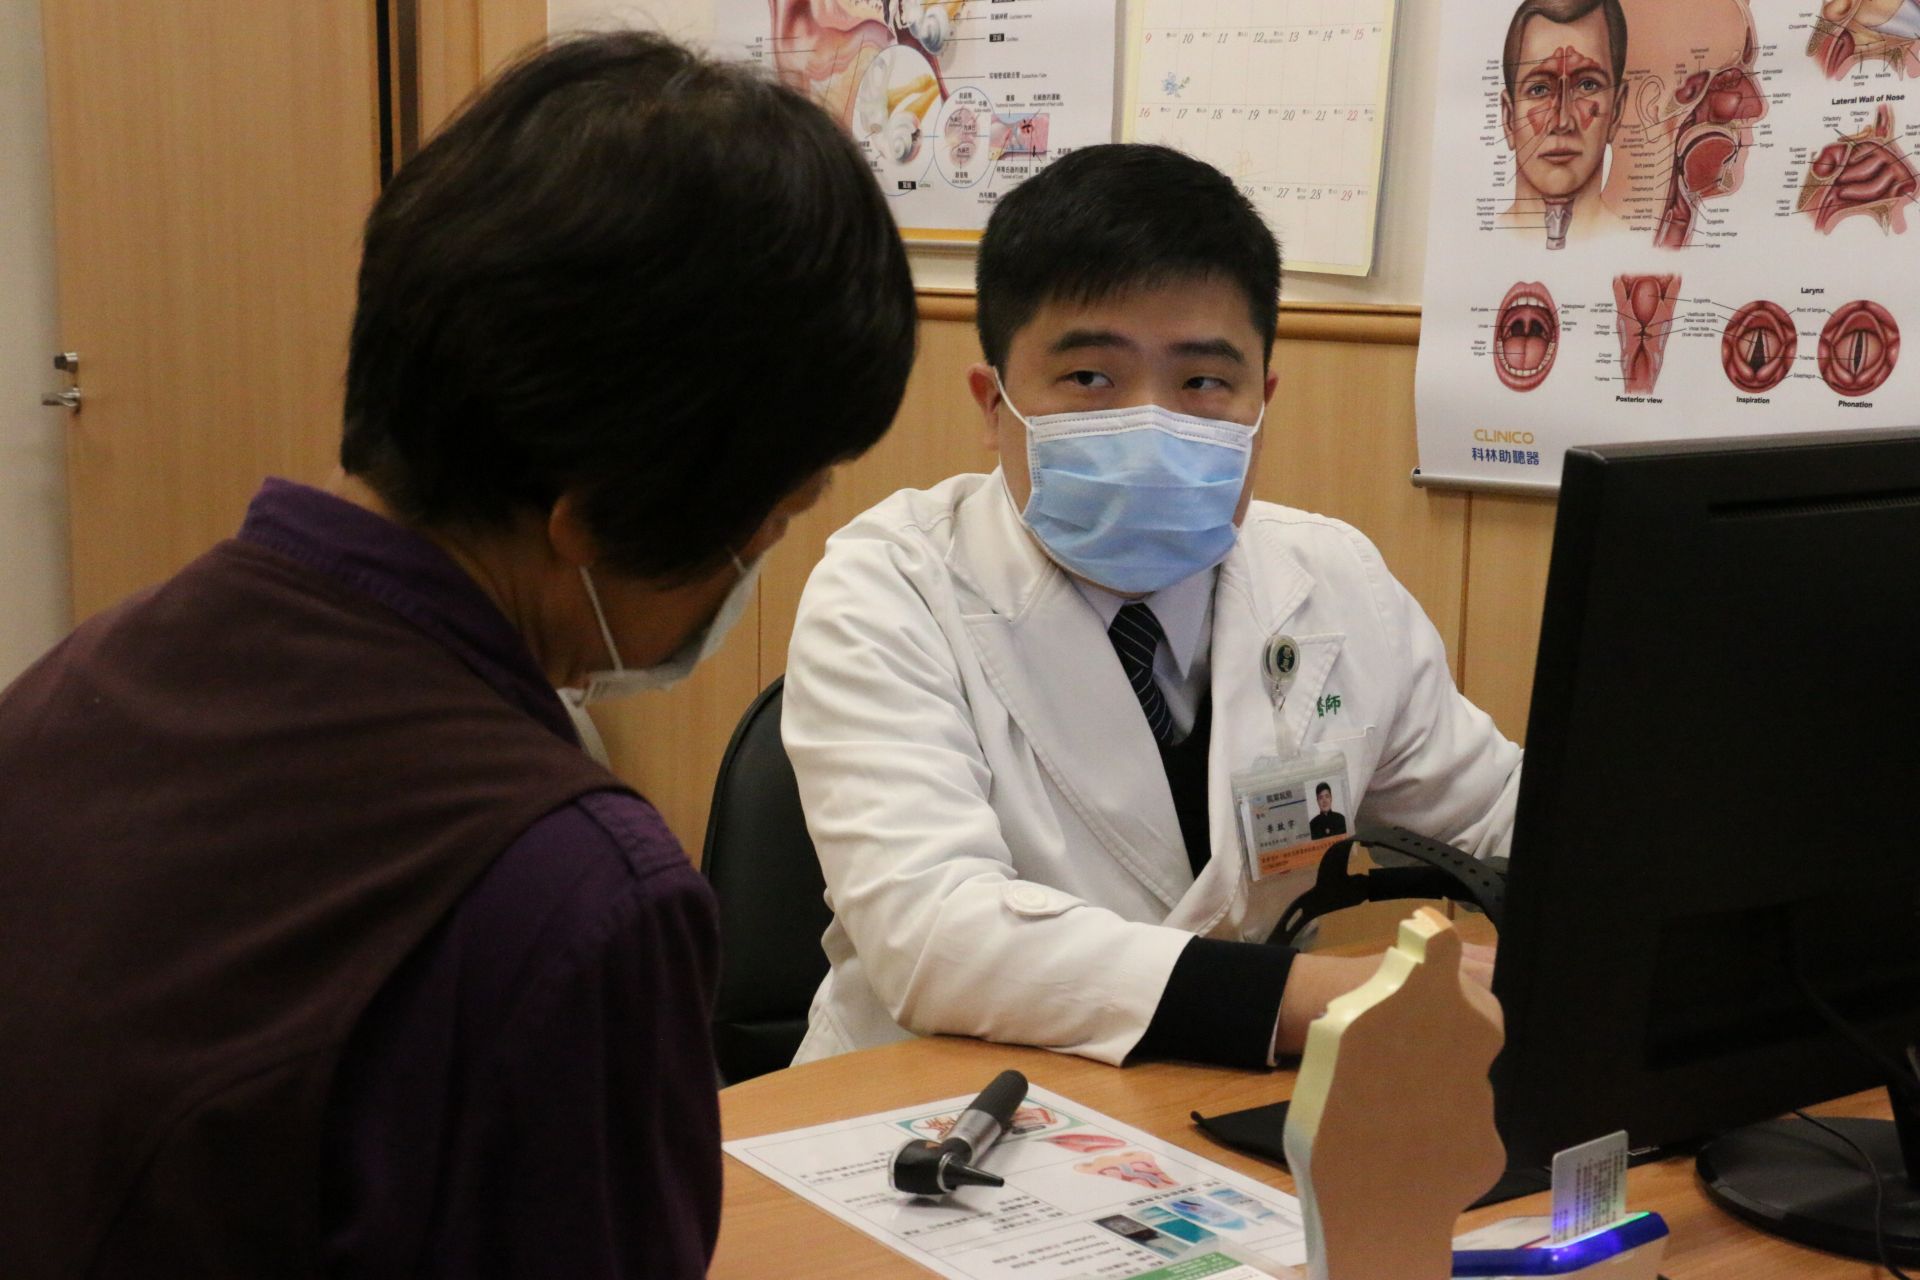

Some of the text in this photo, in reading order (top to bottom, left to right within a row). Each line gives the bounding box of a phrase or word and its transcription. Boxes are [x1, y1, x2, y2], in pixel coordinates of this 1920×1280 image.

[1145, 32, 1153, 44] 9
[1182, 32, 1194, 44] 10
[1217, 32, 1229, 44] 11
[1252, 32, 1264, 44] 12
[1288, 31, 1300, 43] 13
[1322, 29, 1333, 42] 14
[1353, 28, 1365, 41] 15
[1831, 97, 1857, 106] Lateral
[1858, 96, 1875, 104] Wall
[1885, 94, 1905, 102] Nose
[1139, 107, 1359, 122] 16 17 18 19 20 21 22
[1242, 185, 1353, 201] 26 27 28 29
[1800, 287, 1825, 295] Larynx
[1615, 395, 1646, 403] Posterior
[1736, 395, 1770, 405] Inspiration
[1838, 400, 1873, 409] Phonation
[1473, 428, 1535, 445] CLINICO
[1471, 447, 1540, 466] 科林助聽器
